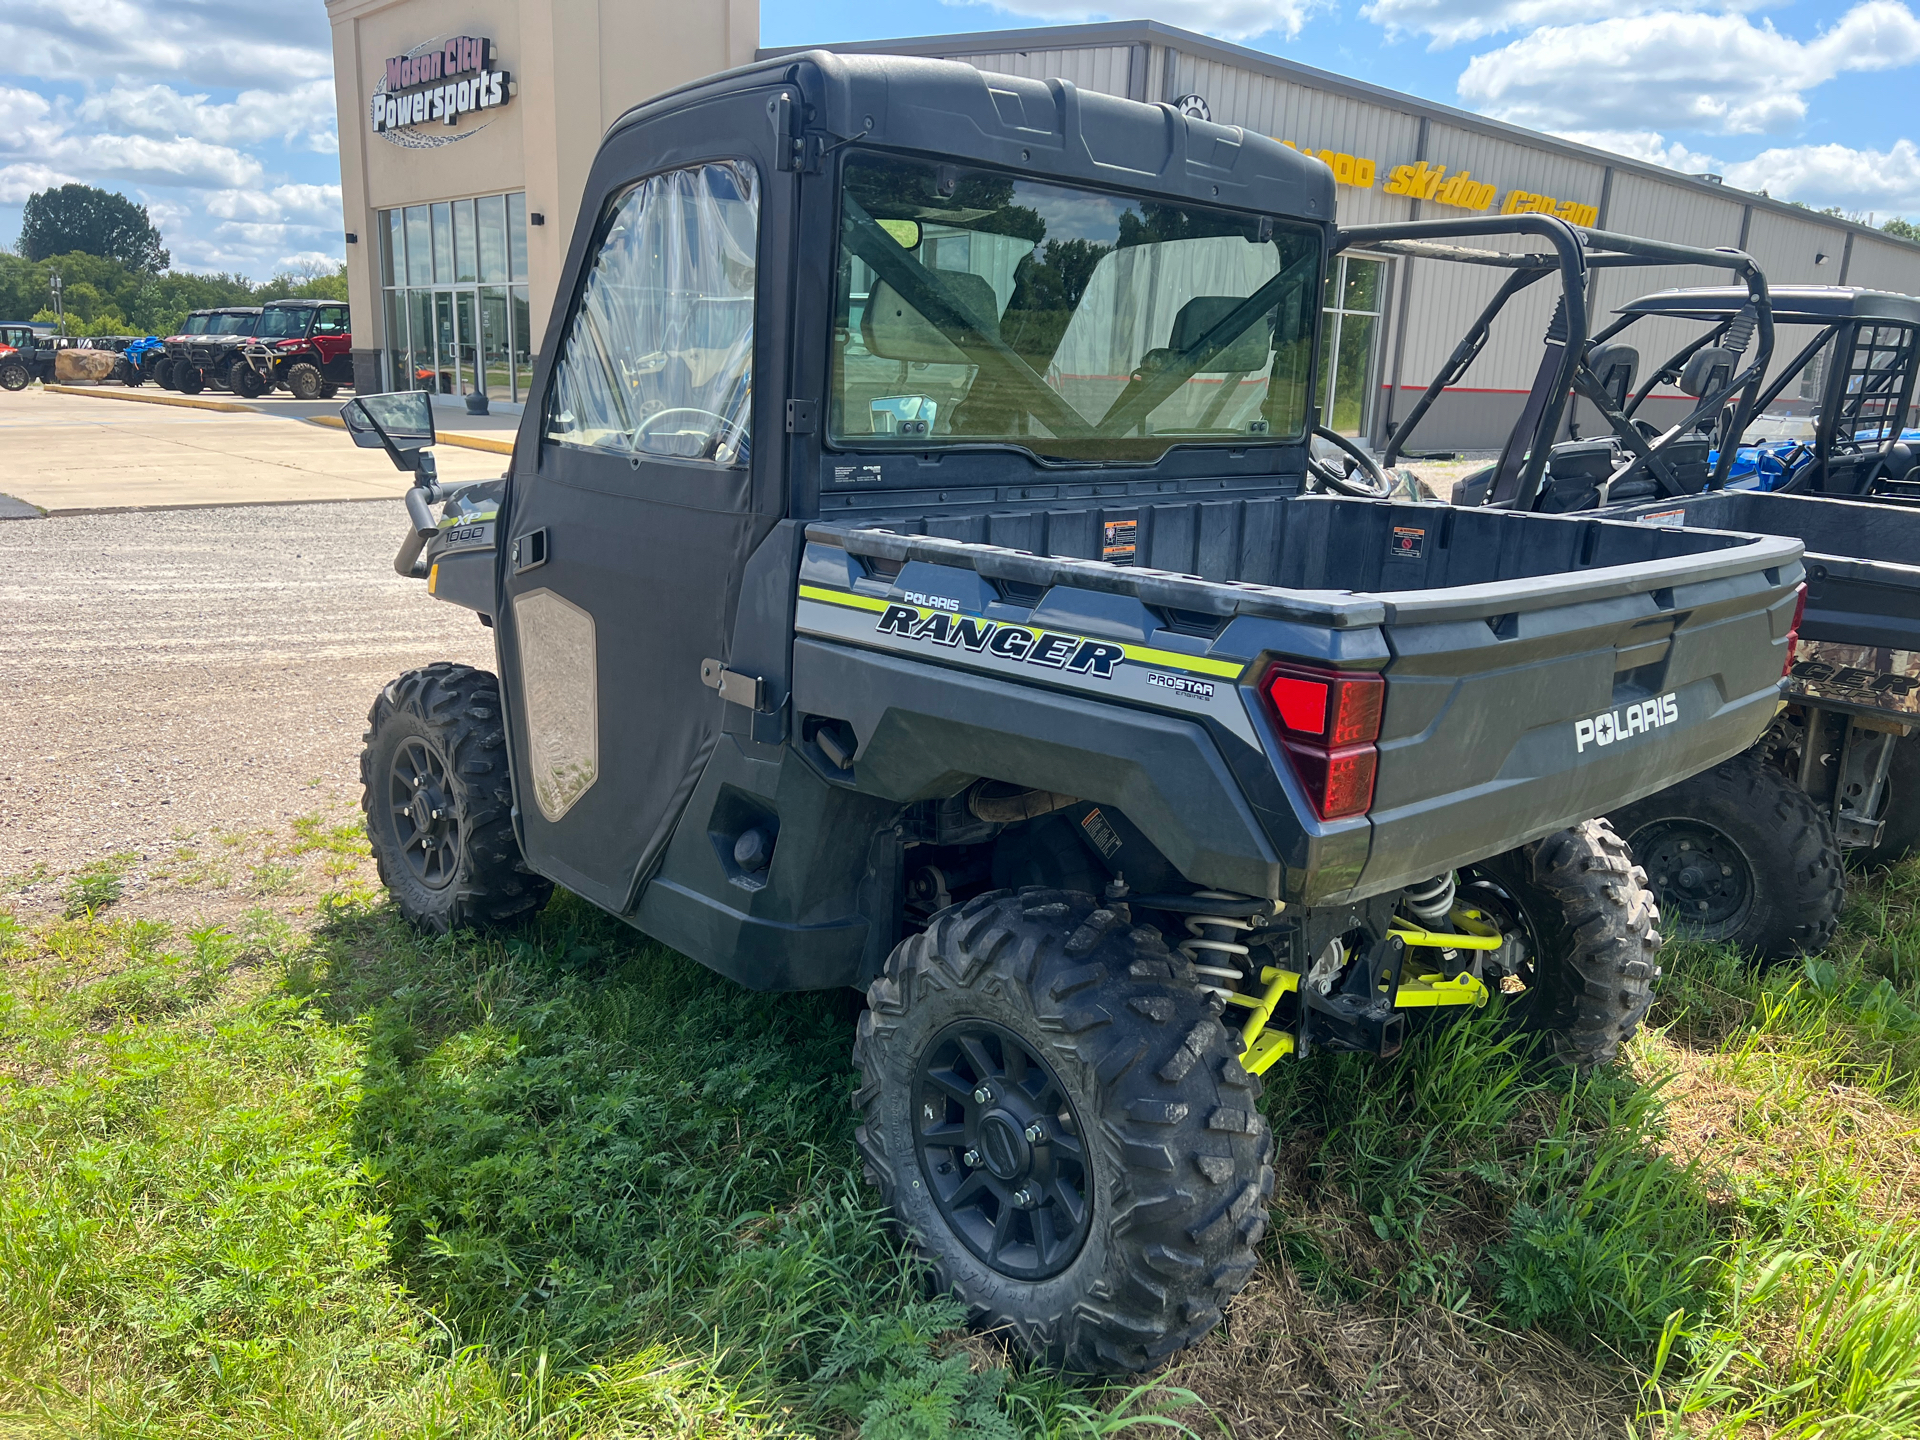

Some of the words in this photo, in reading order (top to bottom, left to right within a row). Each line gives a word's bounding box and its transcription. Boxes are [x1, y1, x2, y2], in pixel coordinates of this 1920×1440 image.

[386, 51, 444, 92] Mason
[445, 36, 487, 76] City
[373, 70, 506, 132] Powersports
[446, 527, 485, 543] 1000
[453, 512, 482, 527] XP
[904, 591, 960, 611] POLARIS
[876, 603, 1125, 679] RANGER
[1147, 673, 1214, 697] PROSTAR
[1575, 692, 1679, 753] POLARIS
